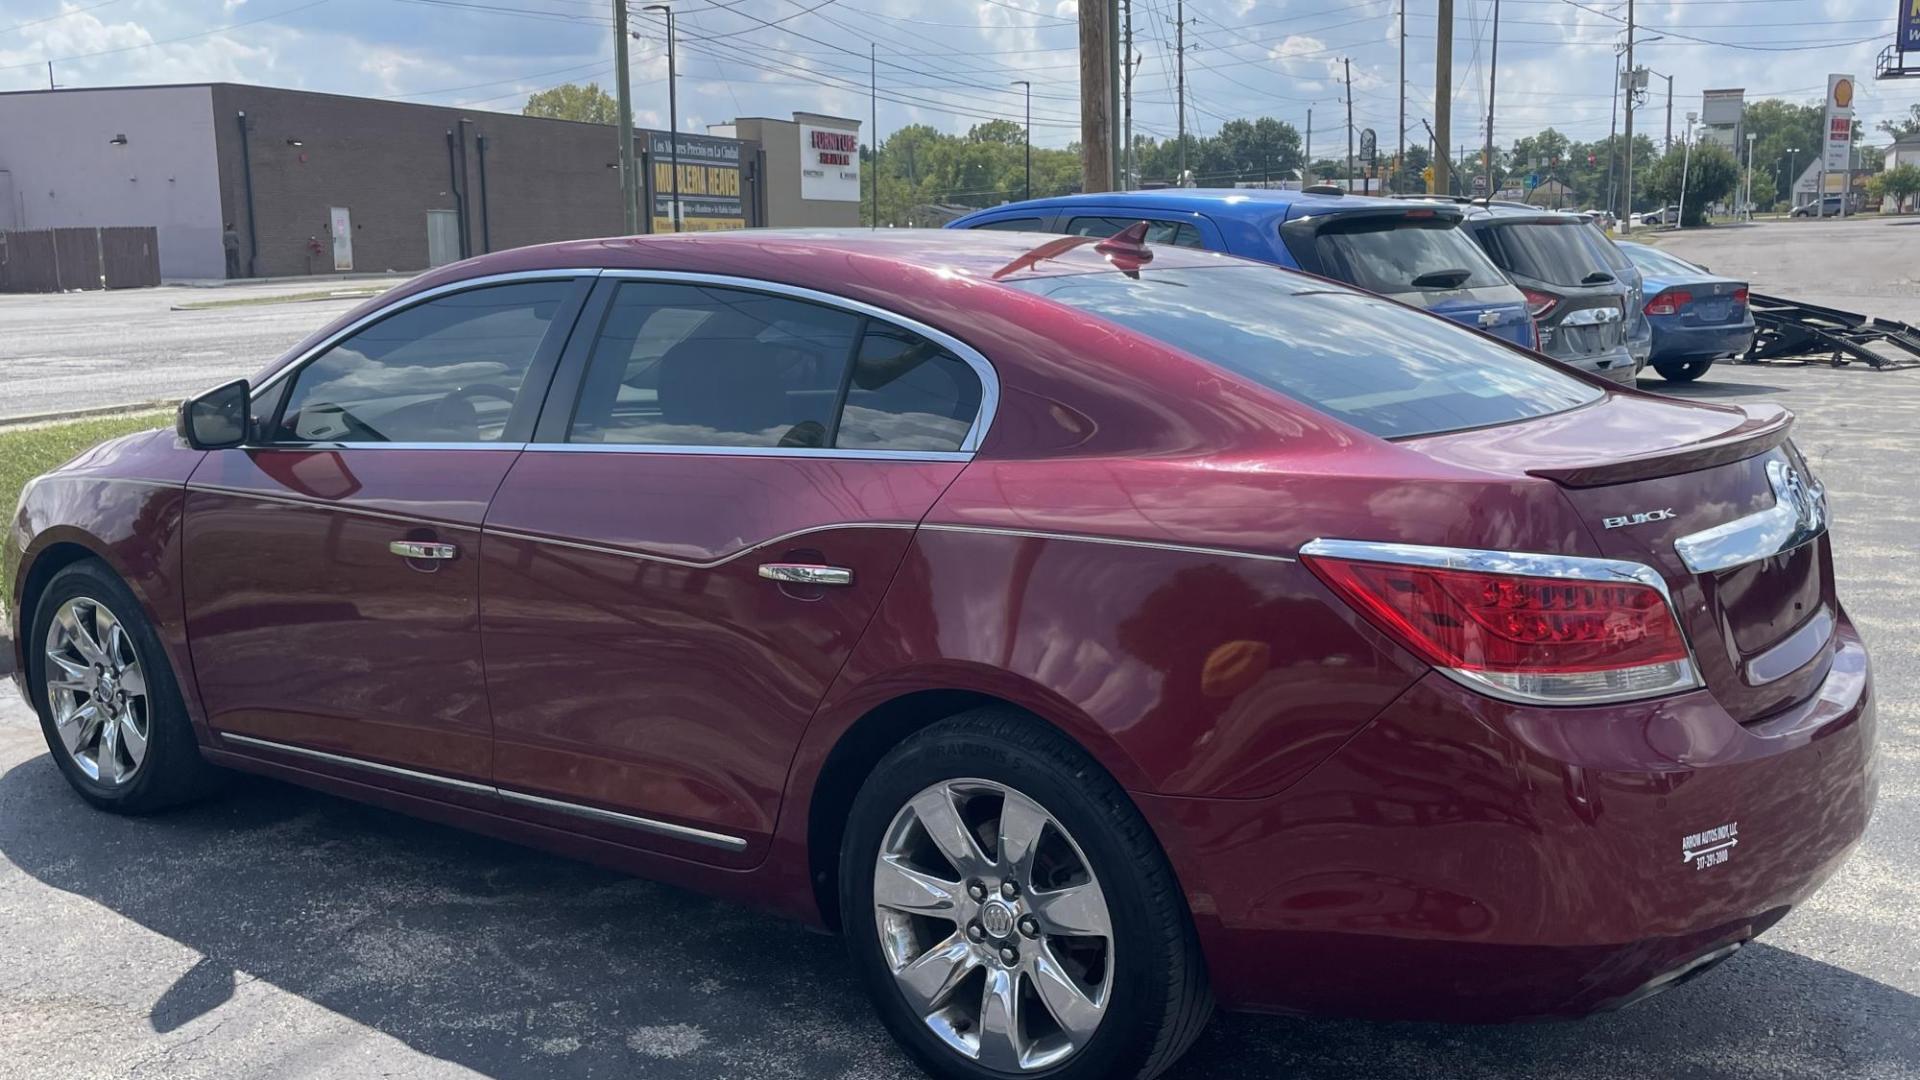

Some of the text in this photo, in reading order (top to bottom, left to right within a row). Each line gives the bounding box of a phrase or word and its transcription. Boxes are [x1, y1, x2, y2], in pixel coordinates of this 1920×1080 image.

[811, 130, 857, 152] FURNITURE
[655, 163, 740, 197] MUBLERIA HEAVEN
[1602, 507, 1677, 529] BUICK
[1682, 832, 1701, 850] ARROW
[1701, 828, 1717, 845] AUTOS
[1729, 821, 1738, 836] LLC
[1696, 848, 1728, 871] 317-291-2000
